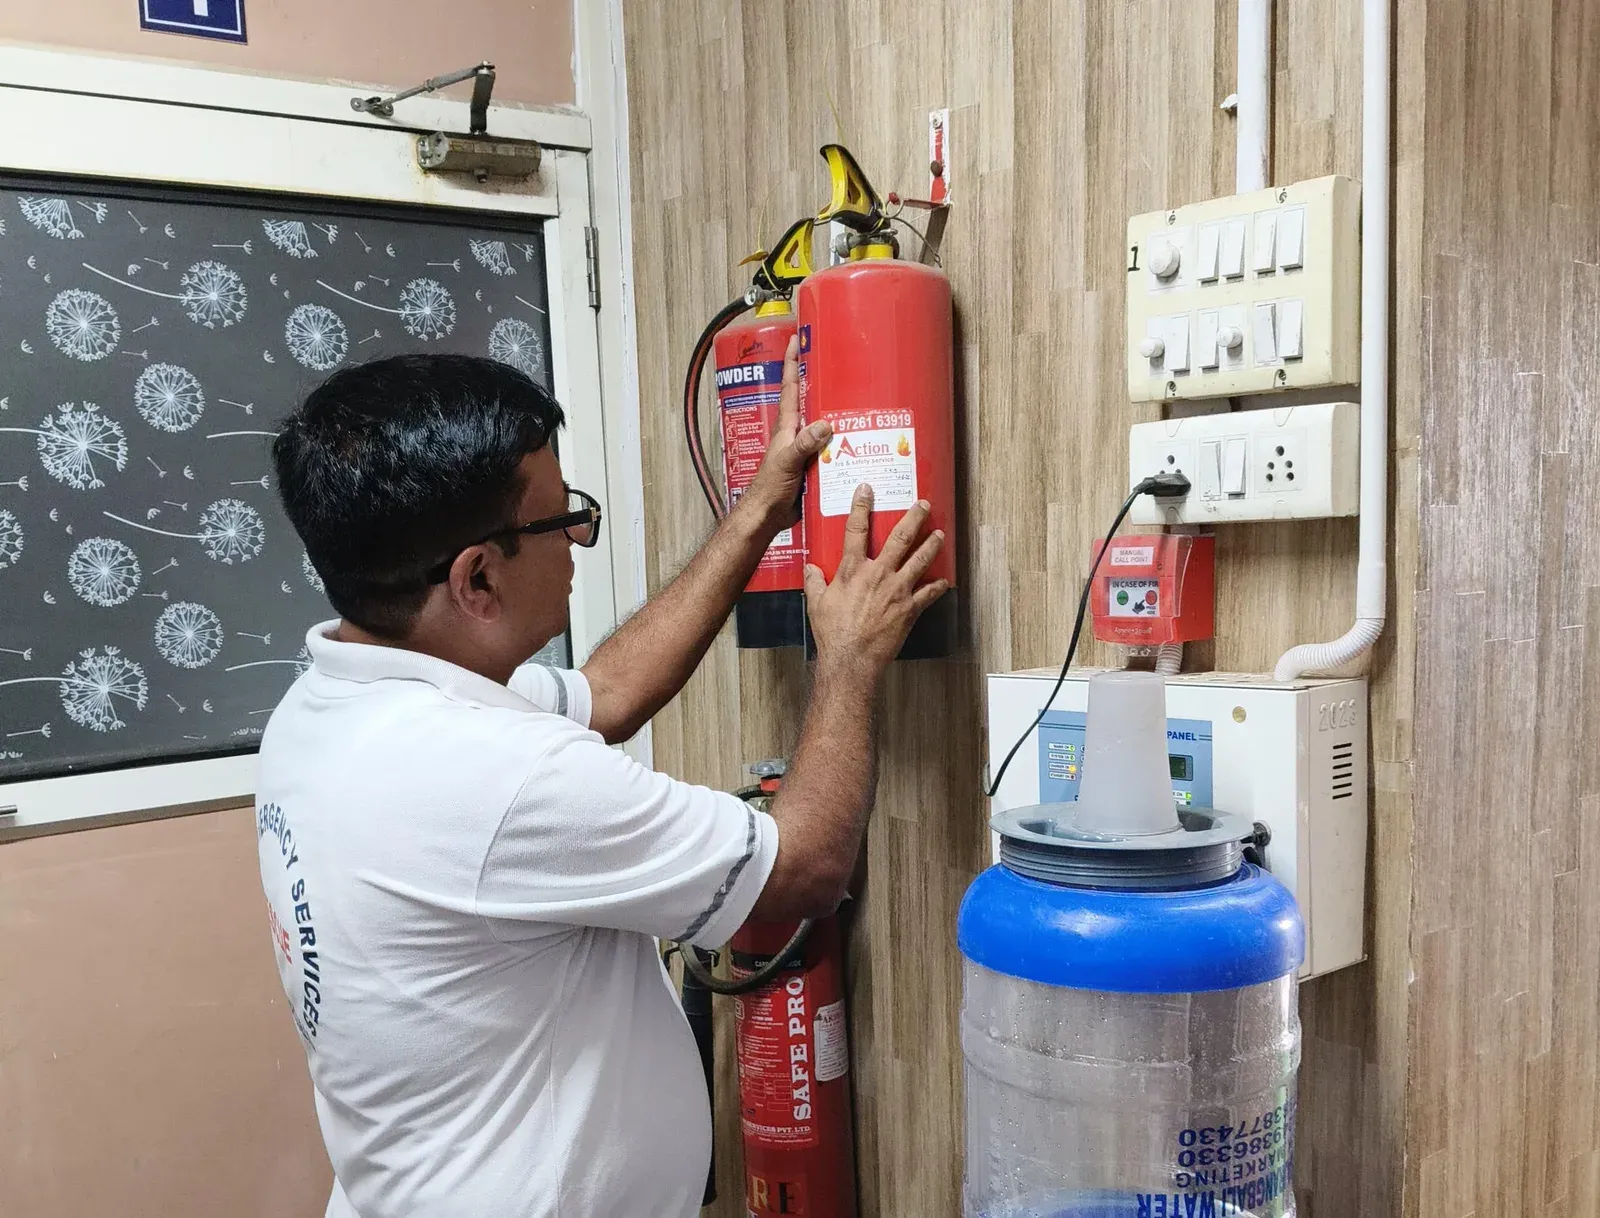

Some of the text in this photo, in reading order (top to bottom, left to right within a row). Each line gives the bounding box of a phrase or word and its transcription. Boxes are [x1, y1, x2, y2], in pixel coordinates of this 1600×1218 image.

[1128, 246, 1140, 272] 1
[839, 416, 872, 431] 97261
[876, 413, 911, 427] 63919
[836, 436, 890, 459] Action
[1120, 580, 1138, 588] CASE
[1138, 580, 1147, 588] OF
[1167, 731, 1197, 741] PANEL
[292, 878, 321, 1038] SERVICES
[786, 976, 806, 1038] PRO
[790, 1043, 811, 1120] SAFE
